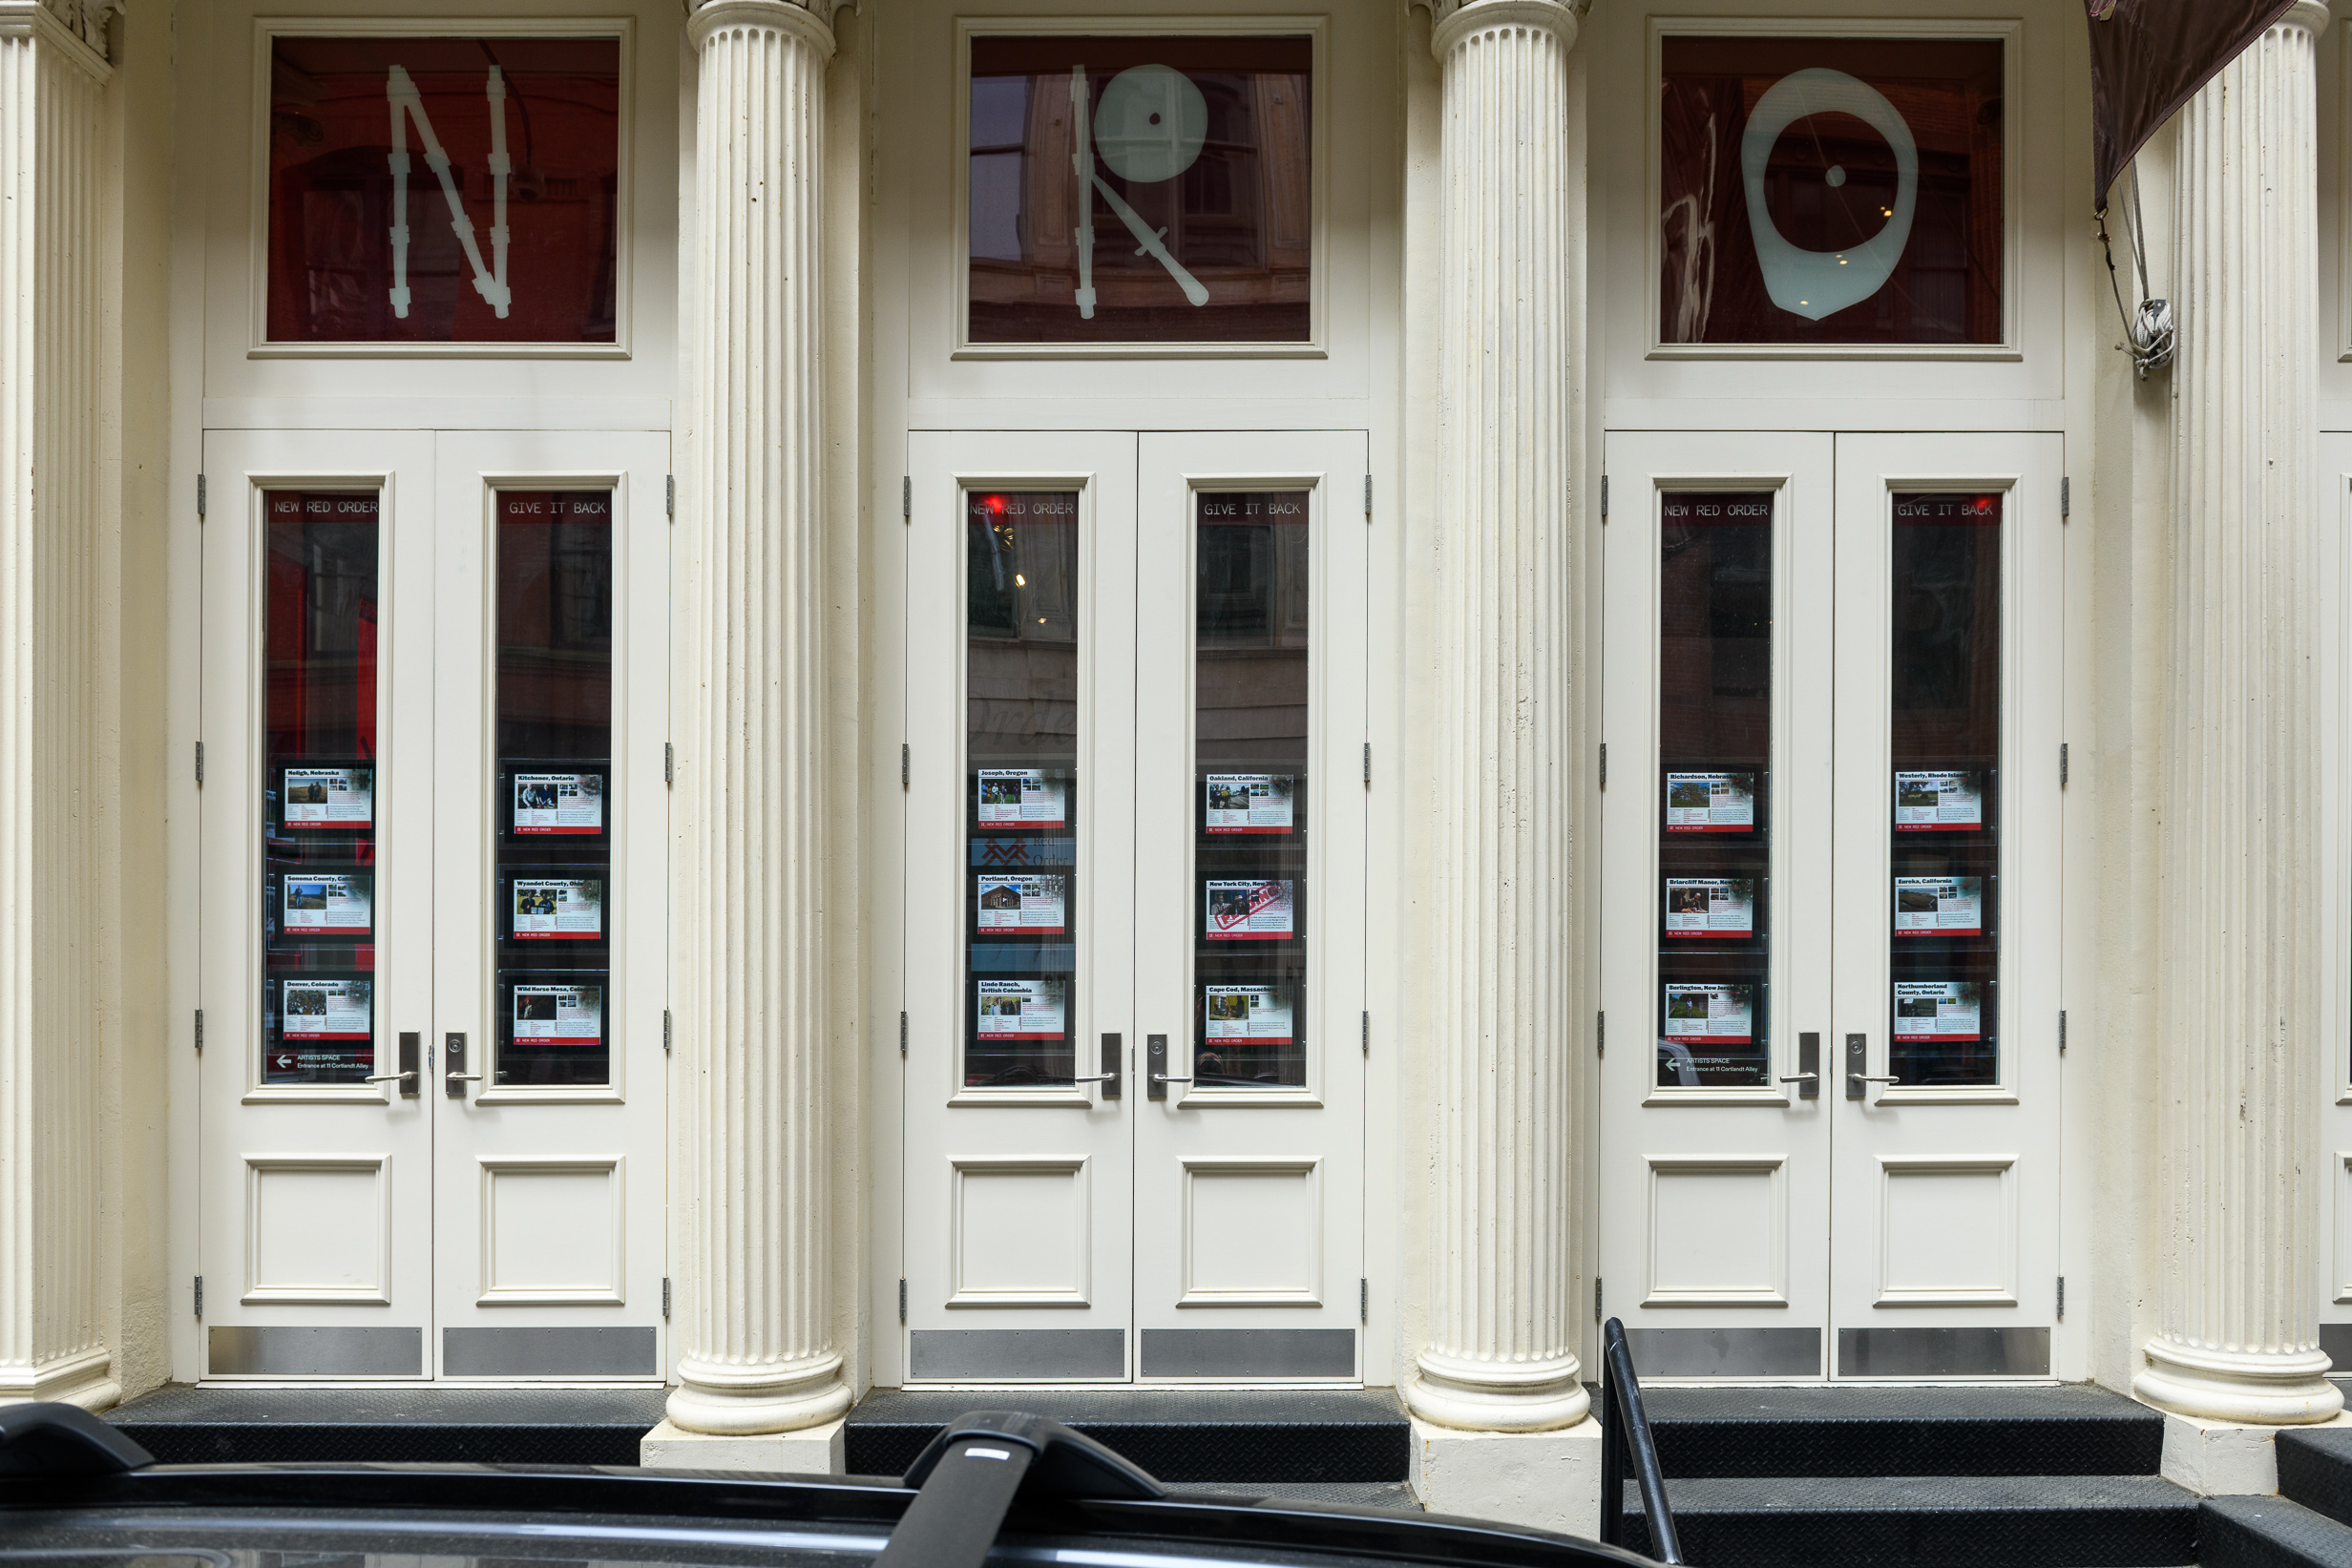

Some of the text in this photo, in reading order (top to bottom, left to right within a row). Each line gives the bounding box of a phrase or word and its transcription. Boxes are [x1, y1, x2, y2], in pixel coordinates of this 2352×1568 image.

[274, 502, 378, 513] NEW RED ORDER
[509, 502, 606, 513] GIVE IT BACK
[970, 503, 1074, 514] NEW RED ORDER
[1205, 503, 1300, 515] GIVE IT BACK
[1665, 505, 1768, 516] NEW RED ORDER
[1898, 504, 1993, 516] GIVE IT BACK
[1033, 854, 1068, 867] Order
